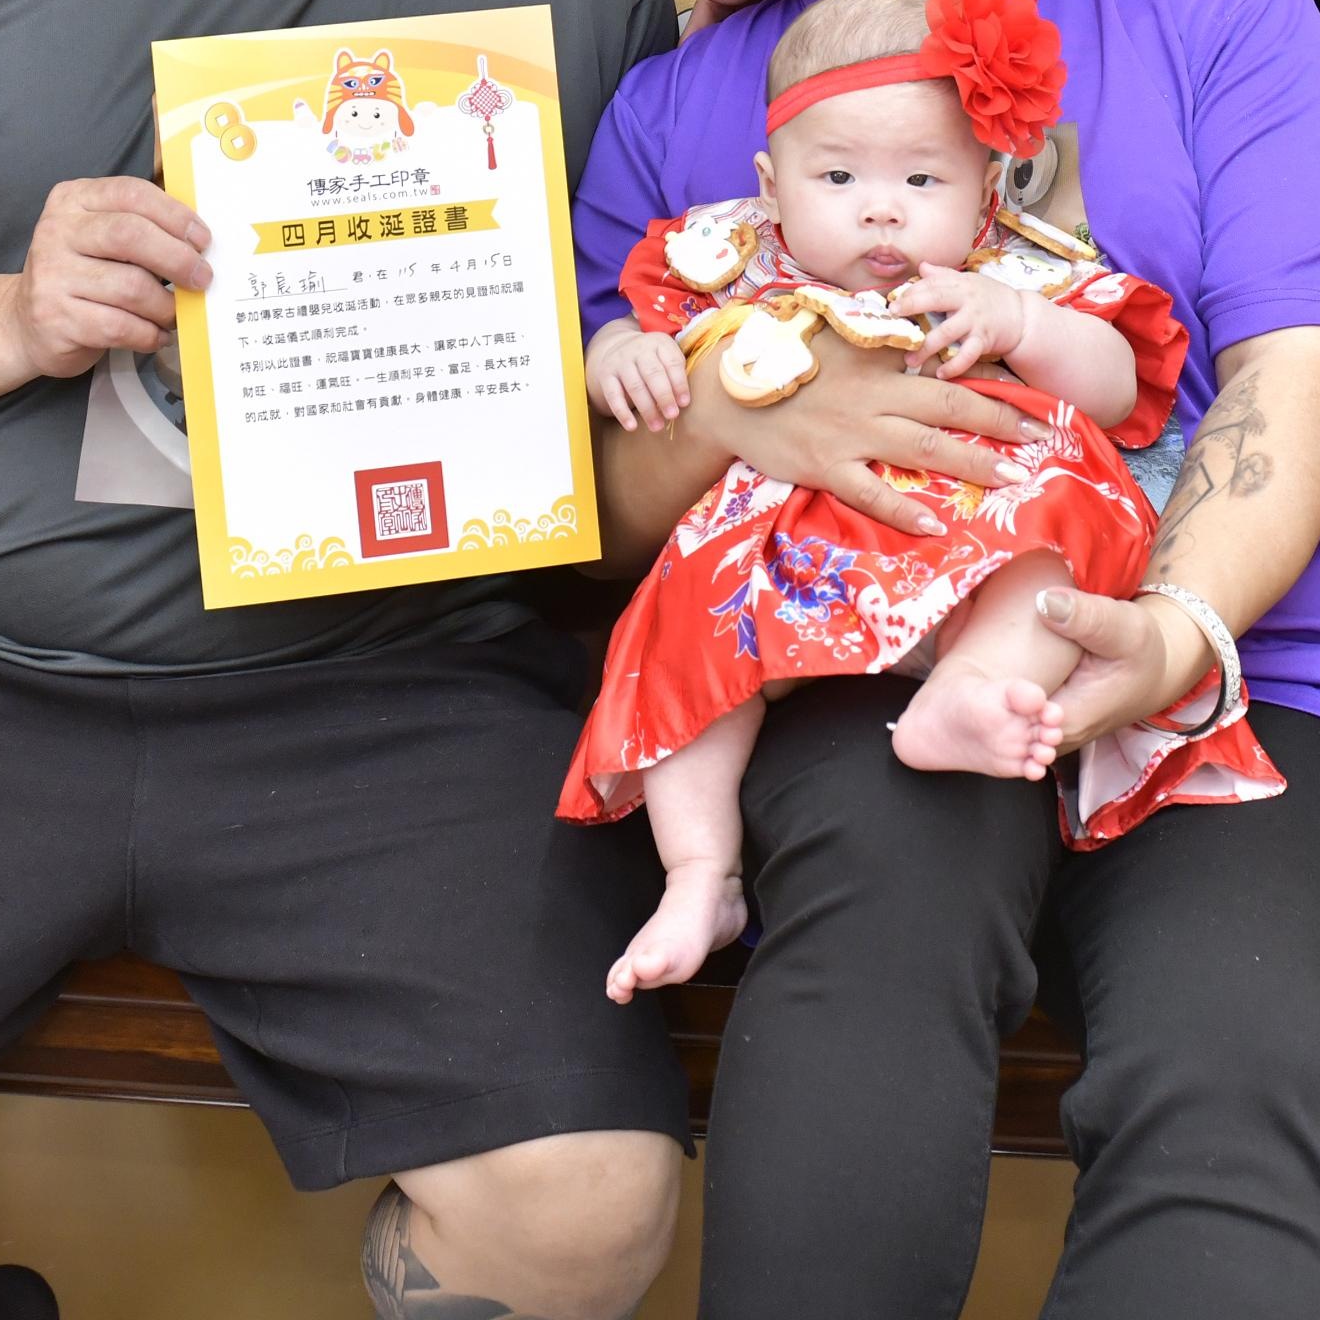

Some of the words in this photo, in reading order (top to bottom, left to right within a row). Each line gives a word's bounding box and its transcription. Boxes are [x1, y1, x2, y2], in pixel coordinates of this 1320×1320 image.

[307, 168, 430, 196] 傳家手工印章
[311, 188, 428, 207] www.seals.com.tw
[282, 206, 469, 247] 四月收涎證書
